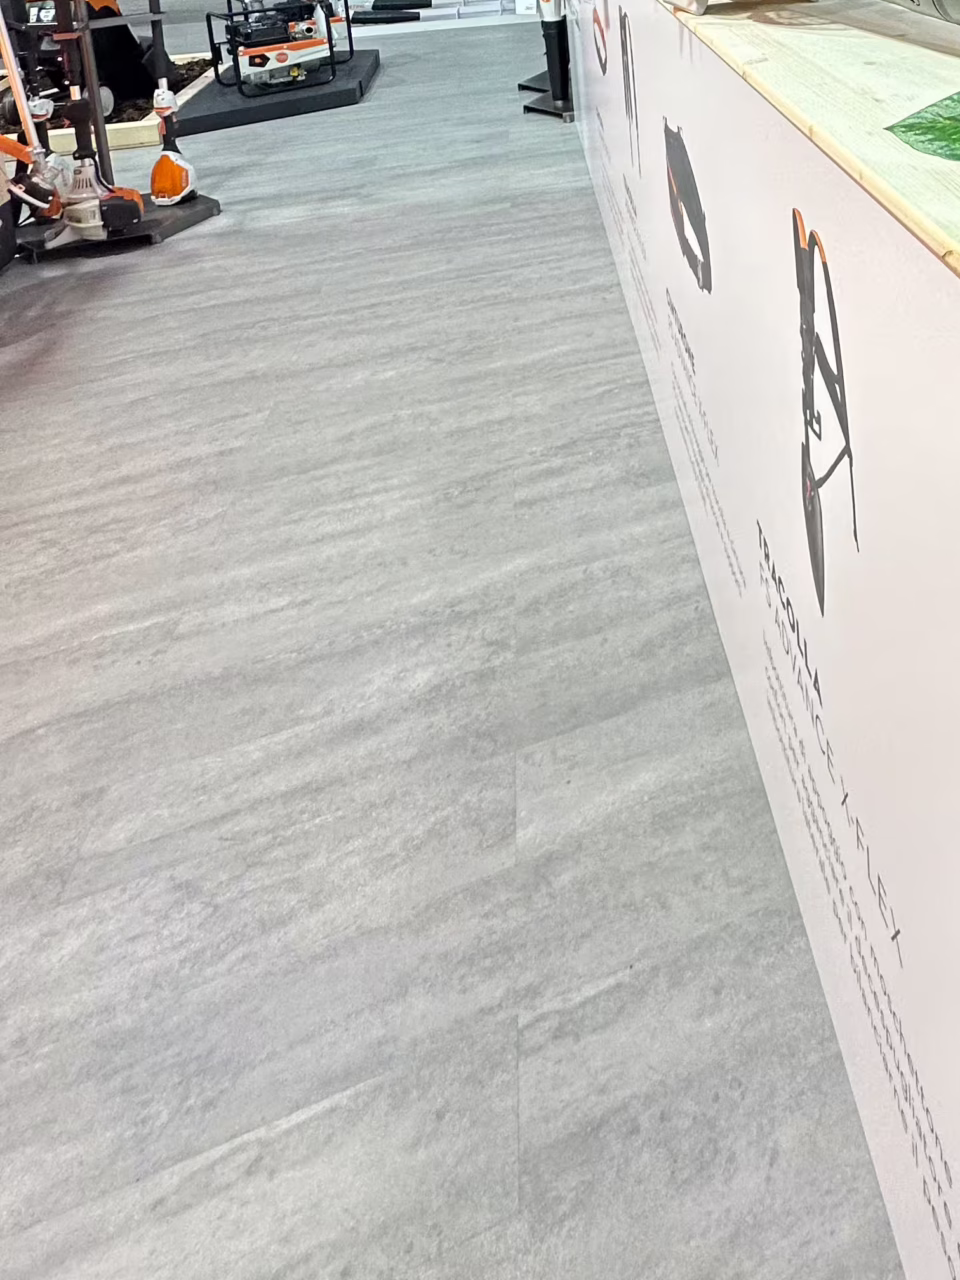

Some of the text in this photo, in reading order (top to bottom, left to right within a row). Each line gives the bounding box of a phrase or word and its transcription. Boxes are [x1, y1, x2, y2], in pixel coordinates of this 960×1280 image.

[756, 518, 823, 707] TRACOLLA
[774, 604, 835, 785] ADVANCE
[840, 775, 903, 969] X-FLEX
